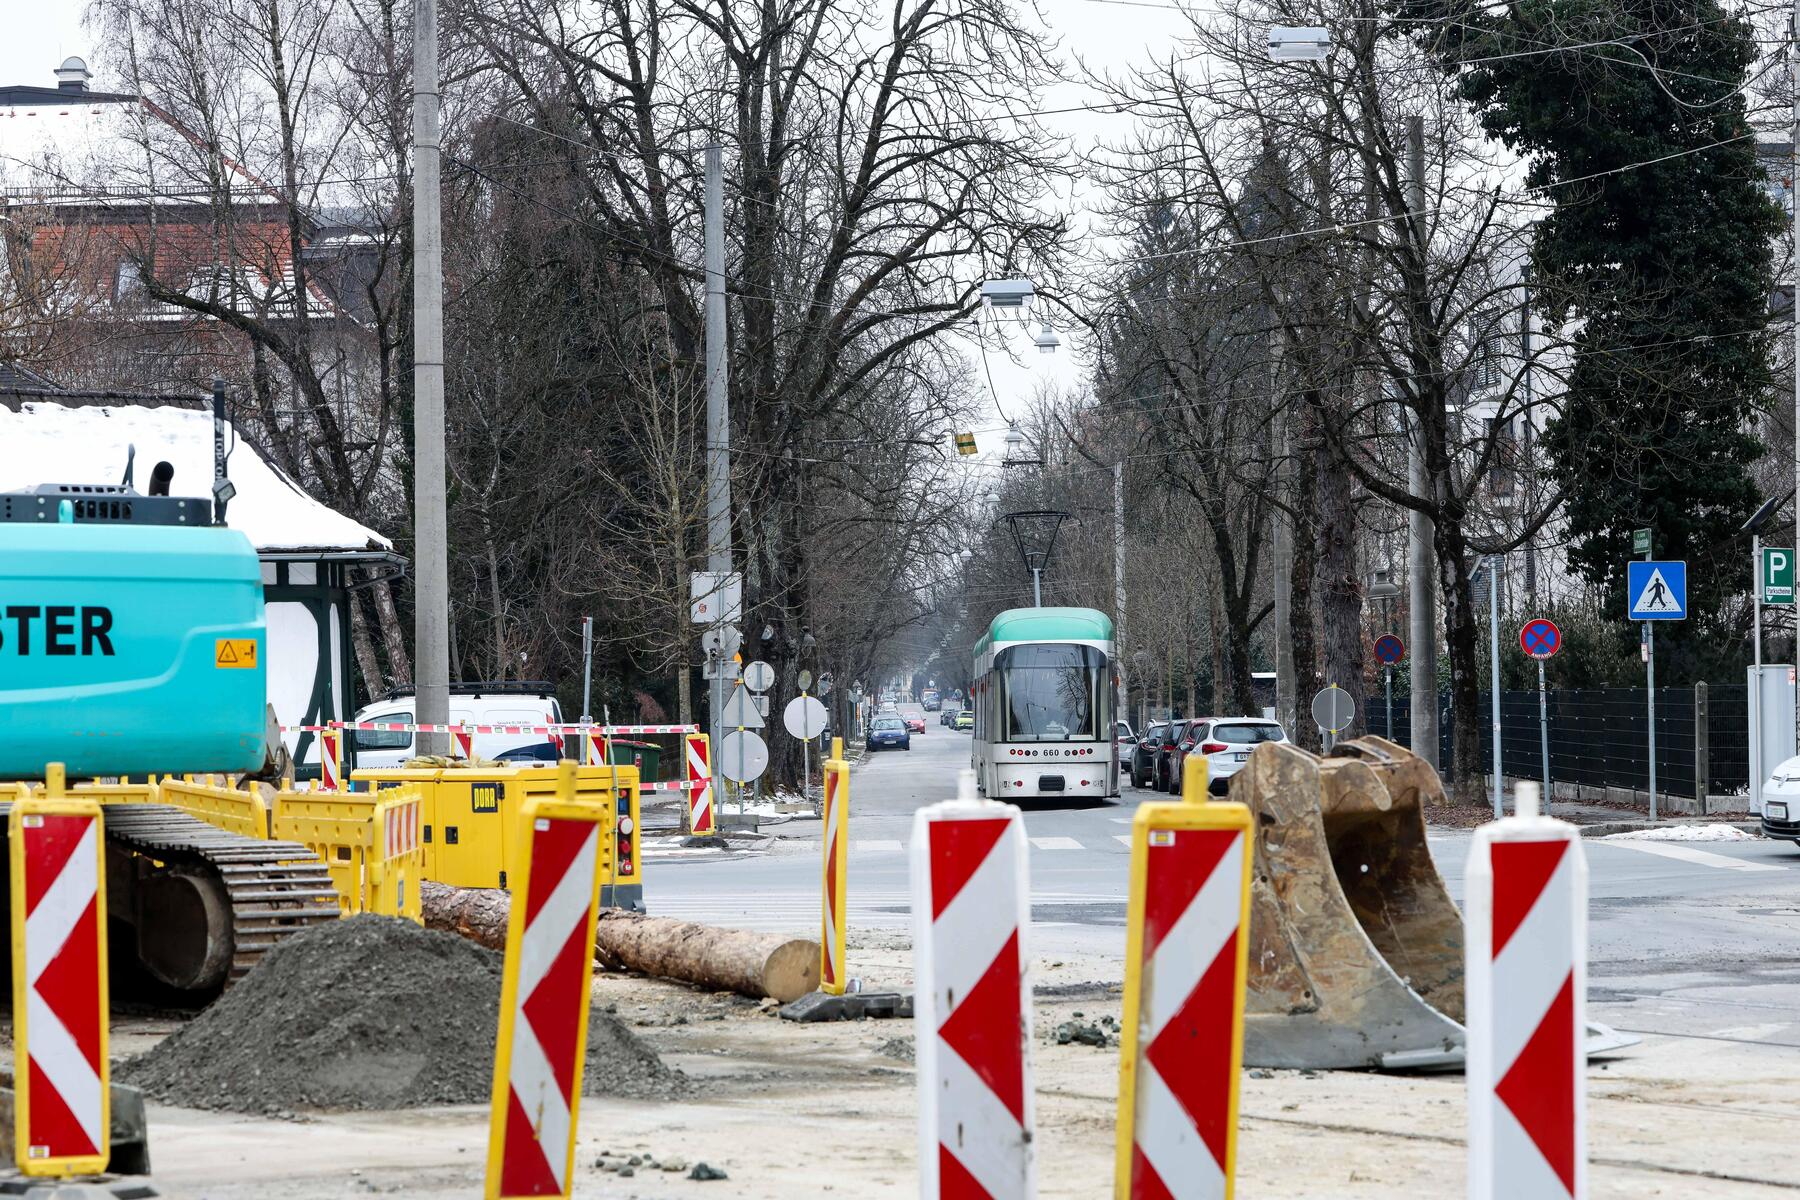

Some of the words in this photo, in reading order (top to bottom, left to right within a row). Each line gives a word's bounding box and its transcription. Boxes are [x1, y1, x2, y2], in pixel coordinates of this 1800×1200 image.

[1770, 552, 1787, 584] P
[0, 606, 115, 656] TER
[1043, 749, 1060, 757] 660
[474, 787, 496, 810] PORR
